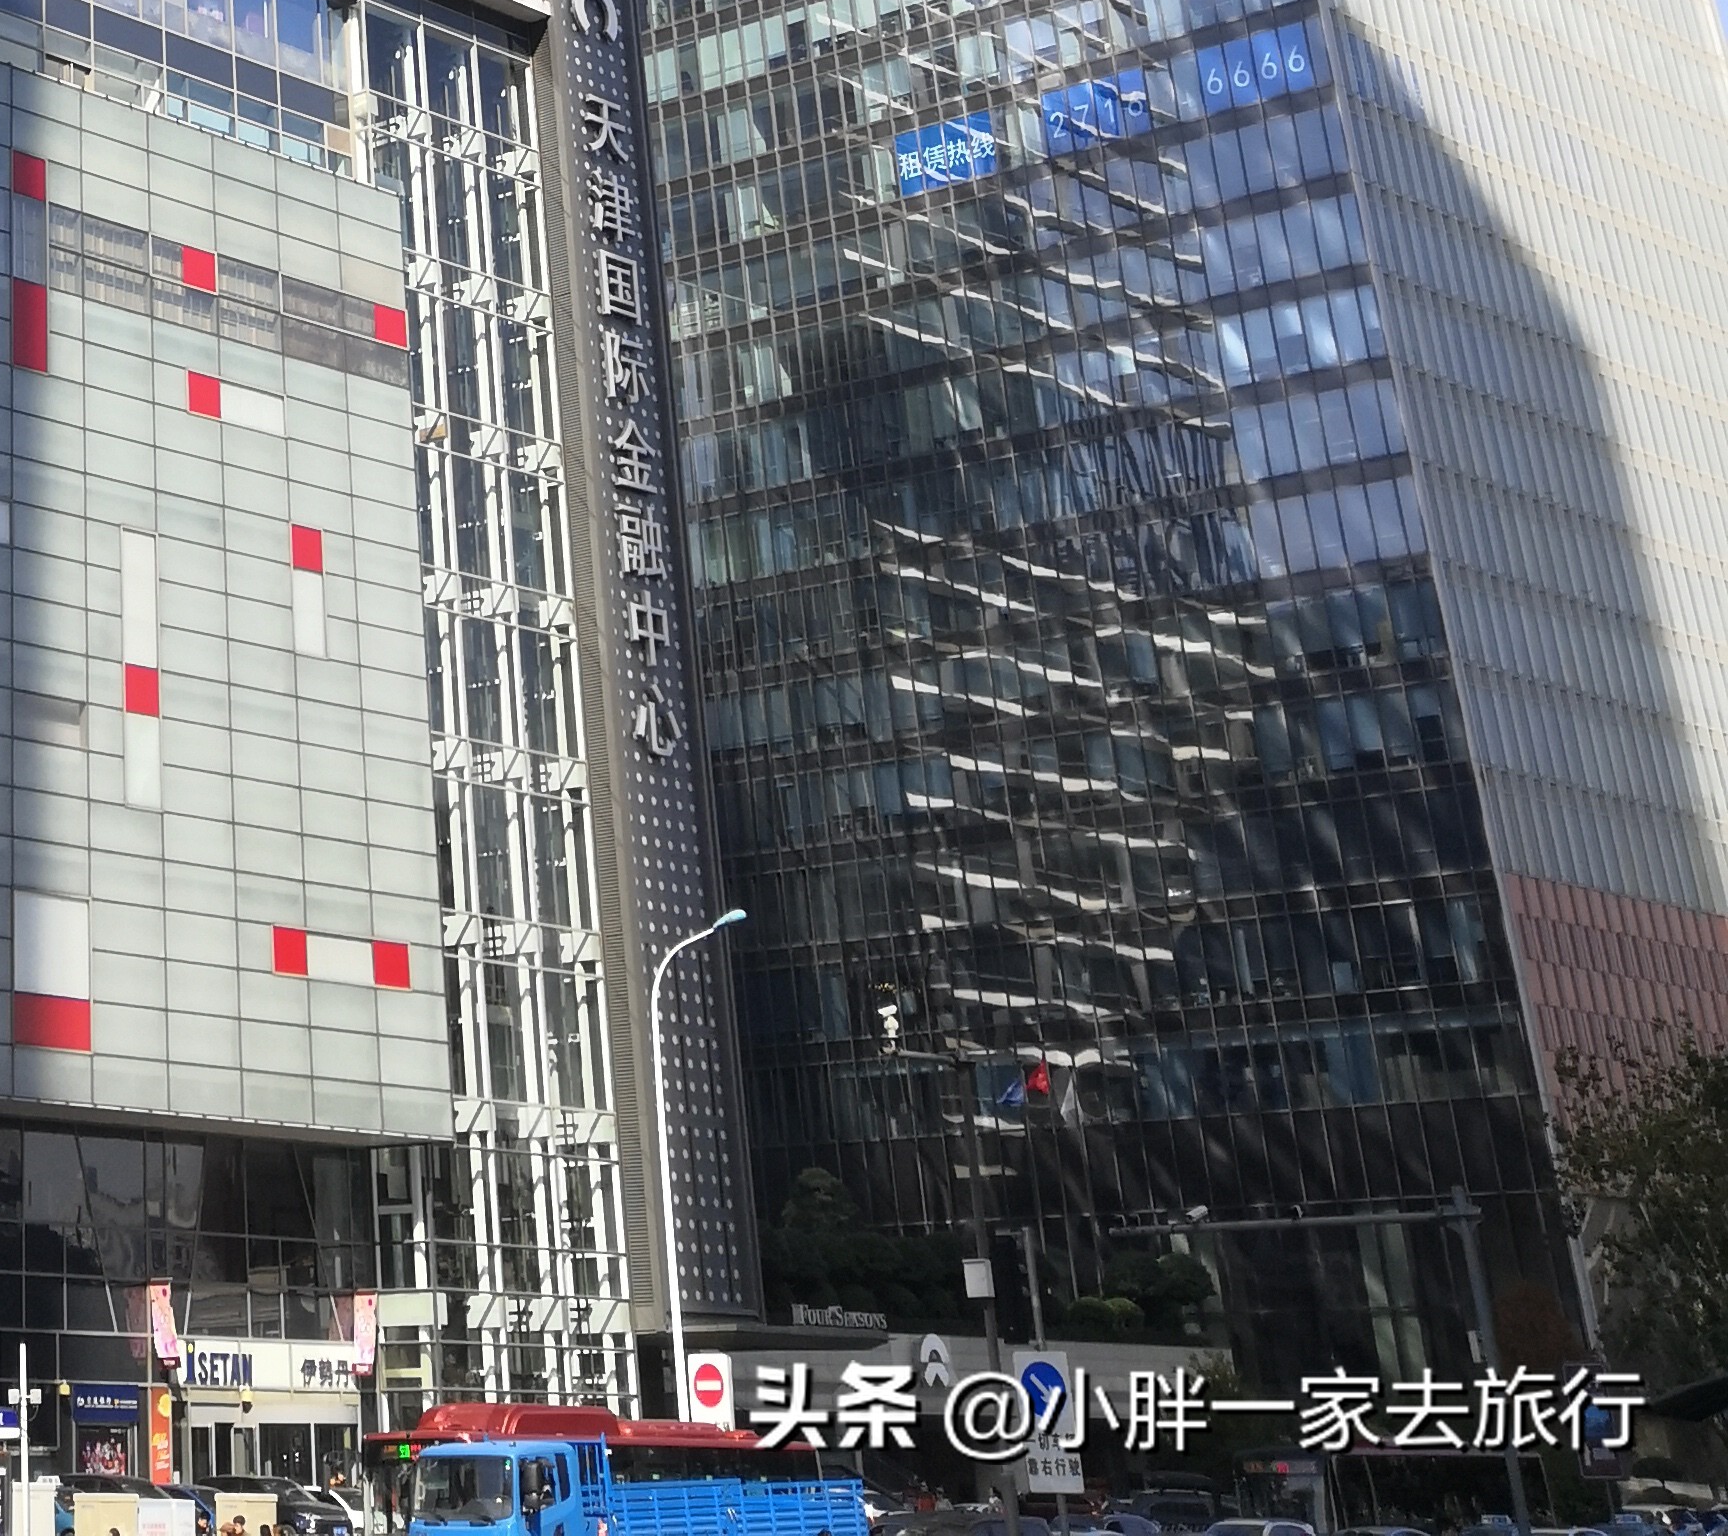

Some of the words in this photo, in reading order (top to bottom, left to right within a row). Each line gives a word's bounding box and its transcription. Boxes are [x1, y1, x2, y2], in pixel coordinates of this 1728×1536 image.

[898, 131, 996, 180] 租赁热线
[1206, 45, 1306, 96] 6666
[584, 94, 682, 757] 天津国际金融中心
[184, 1341, 253, 1386] ISETAN
